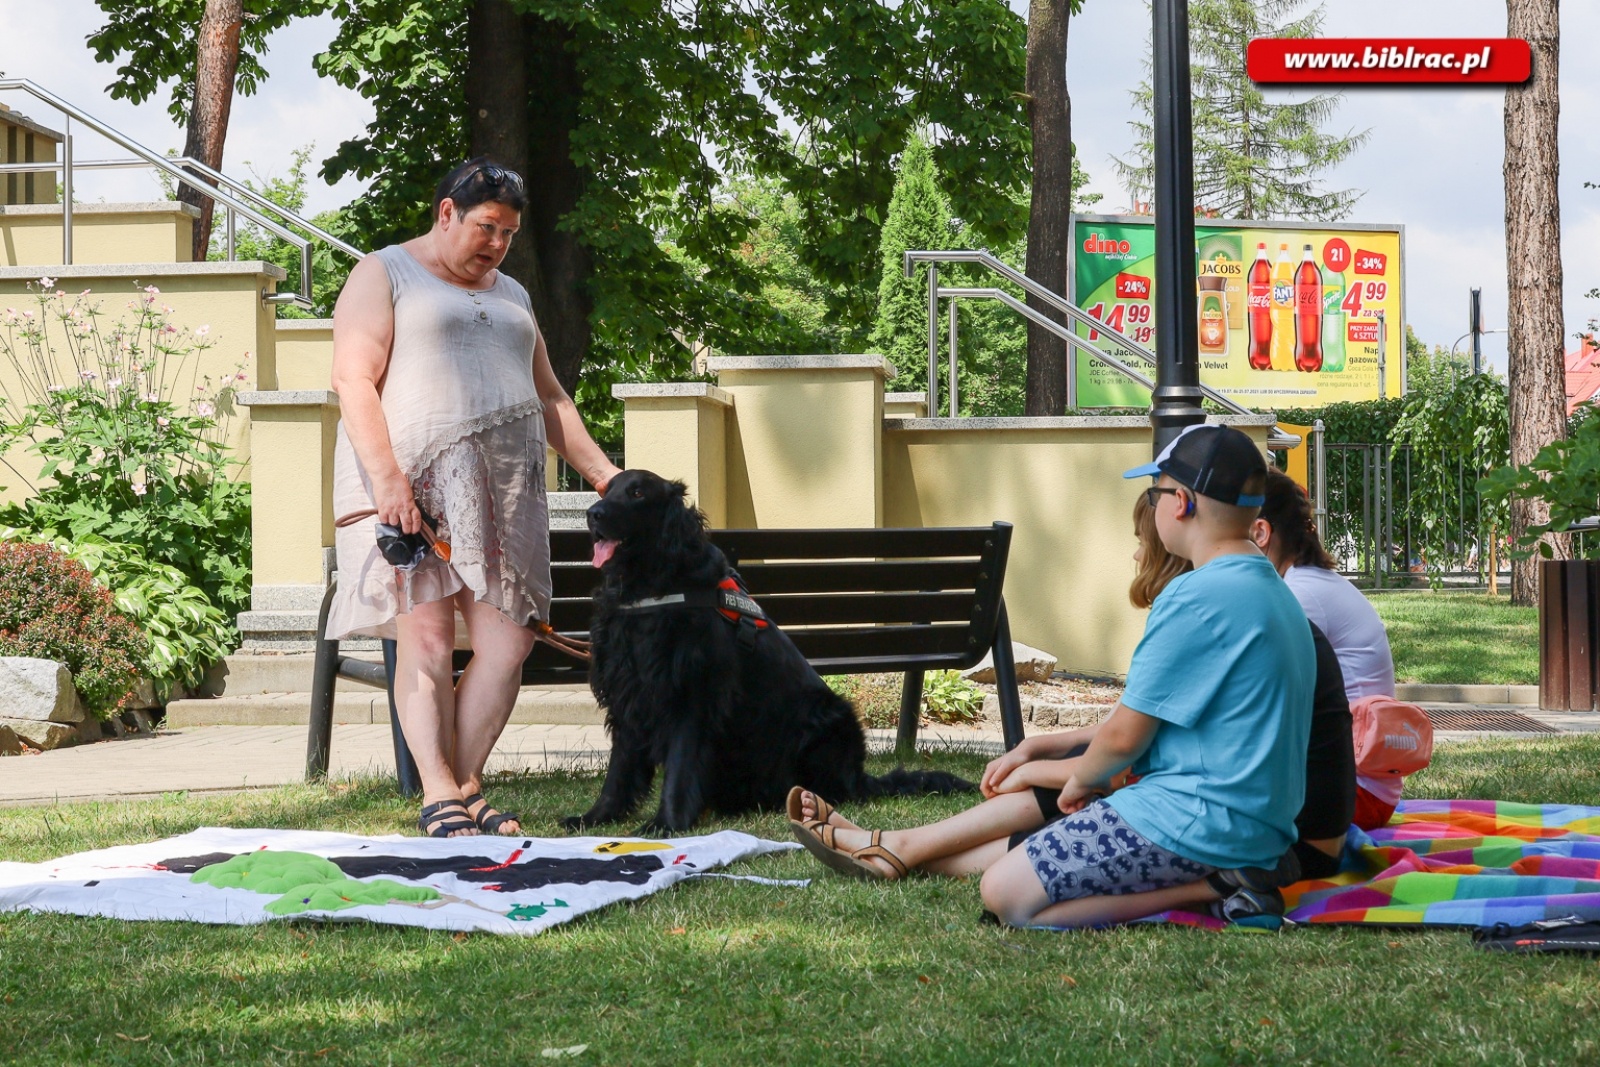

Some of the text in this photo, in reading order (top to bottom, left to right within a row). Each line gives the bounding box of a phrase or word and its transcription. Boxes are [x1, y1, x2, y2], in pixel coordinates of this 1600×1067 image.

[1083, 233, 1131, 254] dino
[1202, 264, 1241, 274] JACOBS
[1273, 286, 1294, 298] FANT
[1342, 282, 1386, 317] 4 99
[1087, 303, 1151, 341] 14 99
[1364, 347, 1378, 355] Nap
[1384, 735, 1417, 750] PUMA
